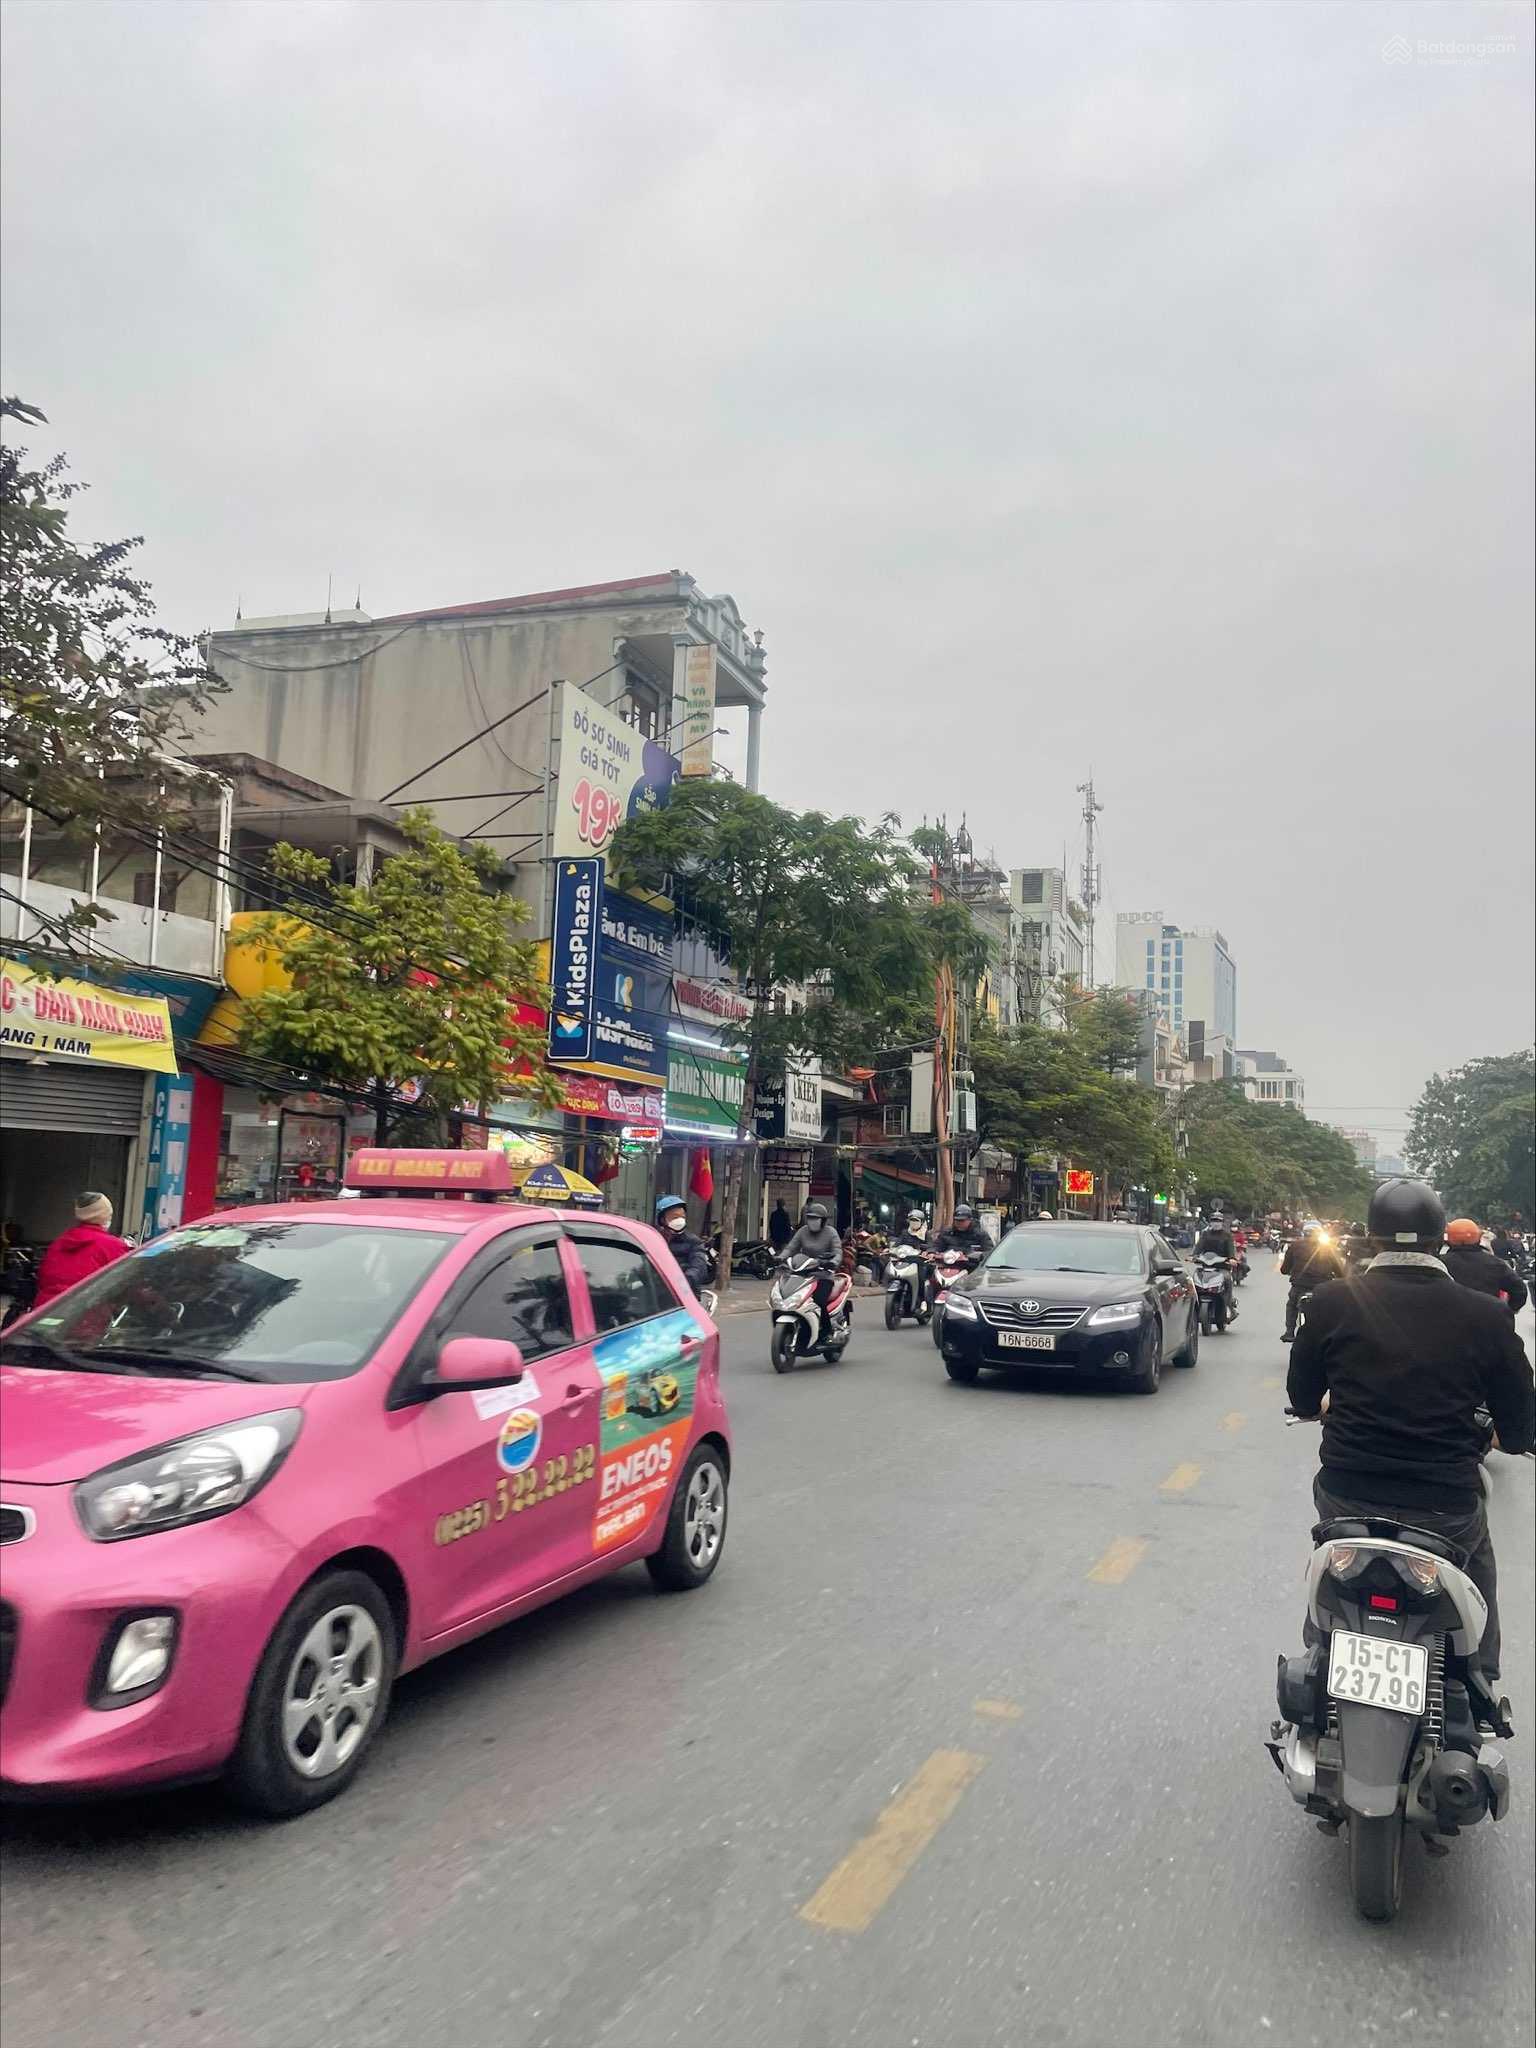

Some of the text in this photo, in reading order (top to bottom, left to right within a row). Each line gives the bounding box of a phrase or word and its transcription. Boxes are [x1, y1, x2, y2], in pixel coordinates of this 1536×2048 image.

[606, 733, 631, 763] SINH
[565, 884, 591, 1006] KidsPlaza
[669, 1058, 700, 1097] RĂNG
[1003, 1334, 1052, 1349] 16N-6668
[600, 1437, 673, 1501] ENEOS
[1368, 1615, 1398, 1625] HONDA
[1347, 1637, 1411, 1677] 15-C1
[1333, 1665, 1420, 1709] 237.96
